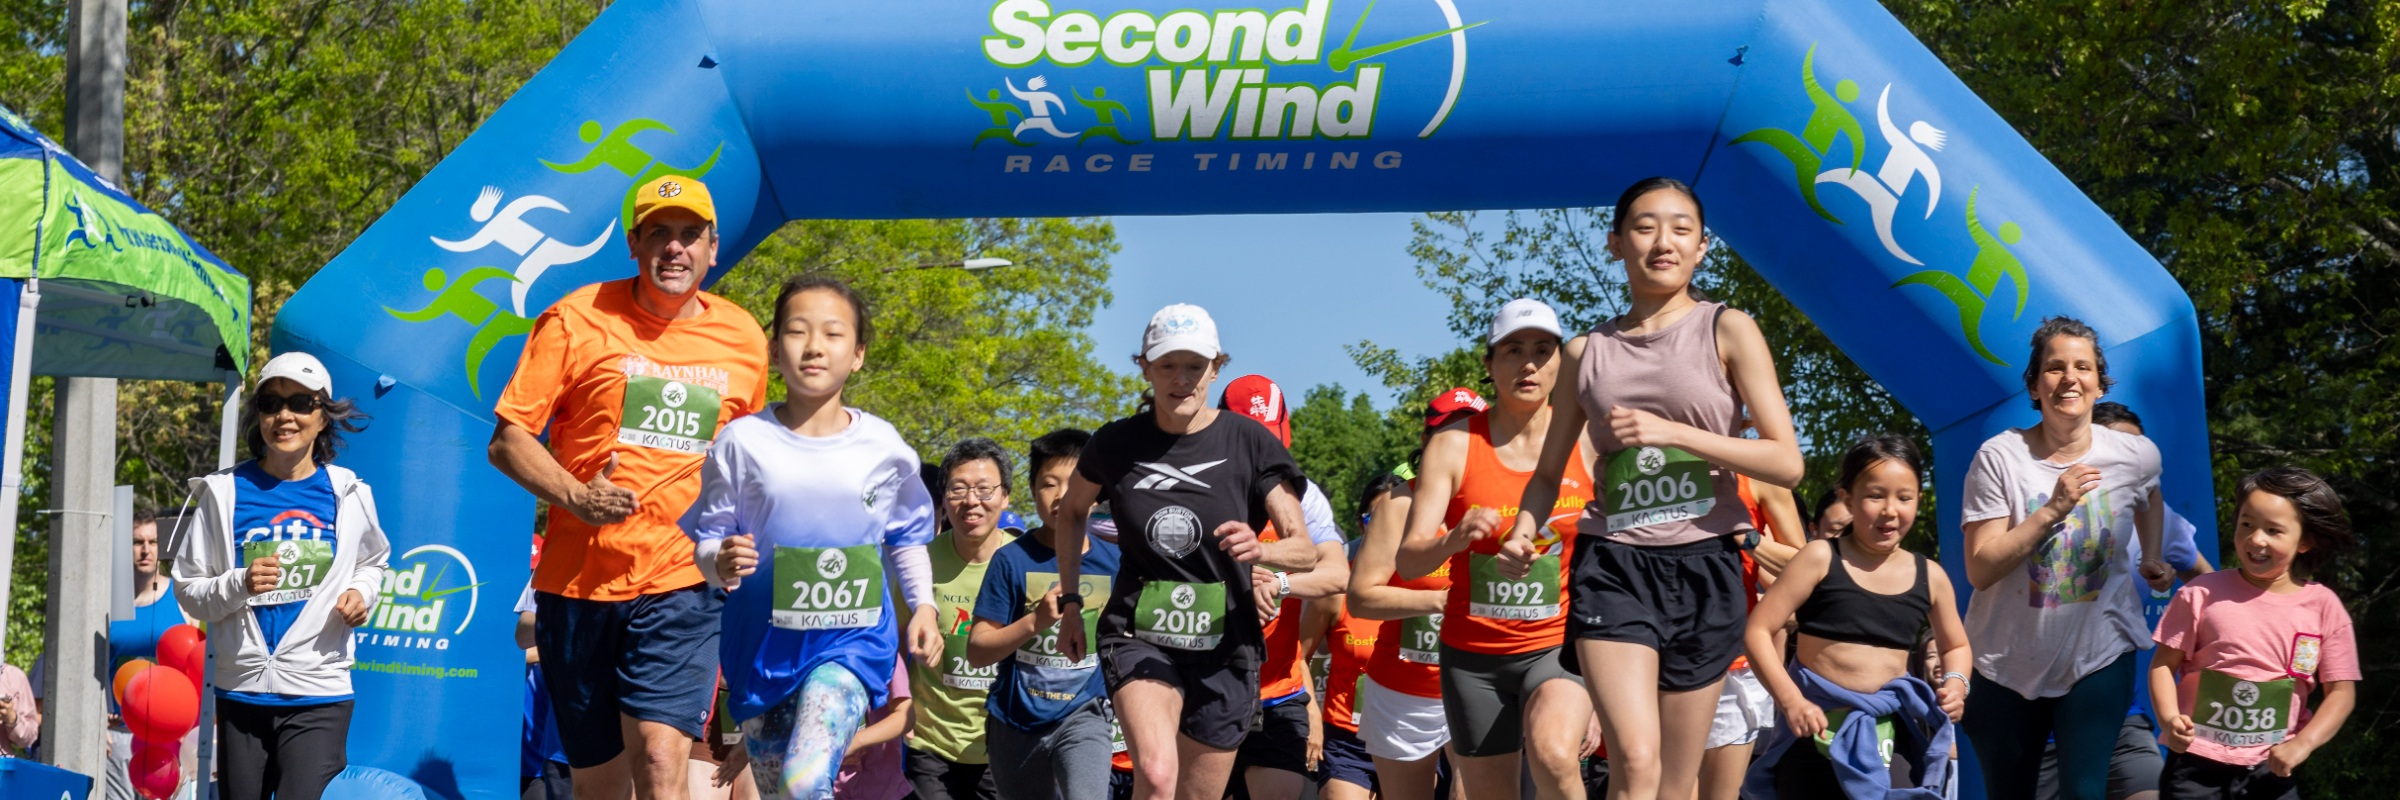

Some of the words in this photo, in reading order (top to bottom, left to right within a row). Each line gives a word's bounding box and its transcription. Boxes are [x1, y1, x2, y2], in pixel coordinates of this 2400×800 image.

[983, 0, 1331, 65] Second
[1146, 65, 1382, 140] Wind
[1004, 153, 1155, 173] RACE
[1193, 150, 1403, 172] TIMING
[652, 364, 729, 386] RAYNHAM
[638, 405, 701, 437] 2015
[642, 433, 691, 451] KACTUS
[1617, 472, 1698, 511] 2006
[1631, 505, 1689, 526] KACTUS
[276, 564, 317, 589] 967
[267, 589, 313, 602] KACTUS
[791, 578, 869, 609] 2067
[1486, 581, 1544, 605] 1992
[801, 613, 858, 628] KACTUS
[1151, 608, 1211, 634] 2018
[1491, 607, 1539, 619] KACTUS
[356, 632, 450, 650] TIMING
[1157, 635, 1204, 648] KACTUS
[1345, 633, 1377, 646] Bost
[1415, 630, 1439, 650] 19
[1418, 653, 1440, 663] KAC
[958, 678, 994, 689] KACTU
[2207, 701, 2276, 731] 2038
[2213, 731, 2265, 744] KACTUS
